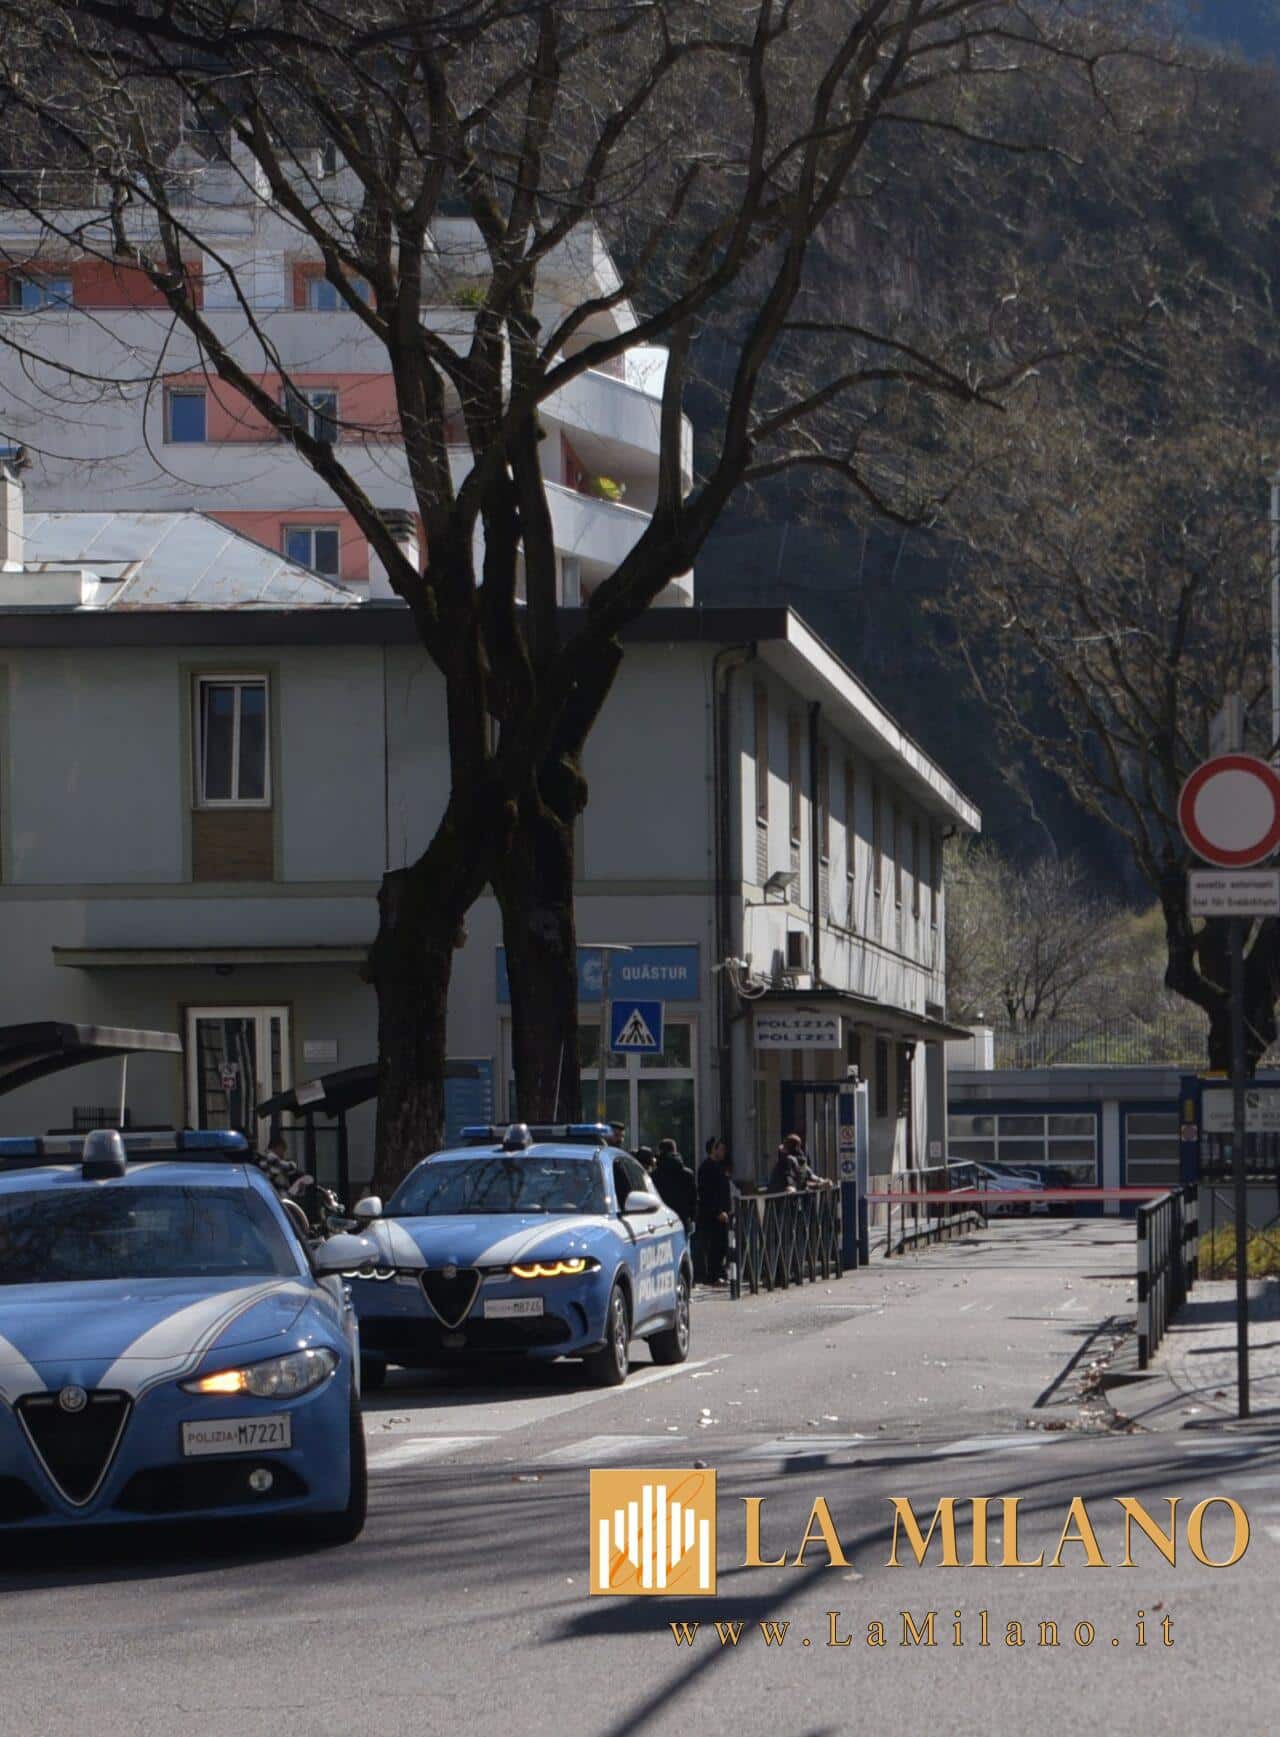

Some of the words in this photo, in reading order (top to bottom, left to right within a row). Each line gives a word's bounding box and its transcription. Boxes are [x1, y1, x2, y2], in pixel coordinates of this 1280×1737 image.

[757, 1020, 836, 1029] POLIZIA
[758, 1033, 835, 1041] POLIZEI
[188, 1430, 233, 1442] POLIZIA
[238, 1422, 285, 1444] M7221
